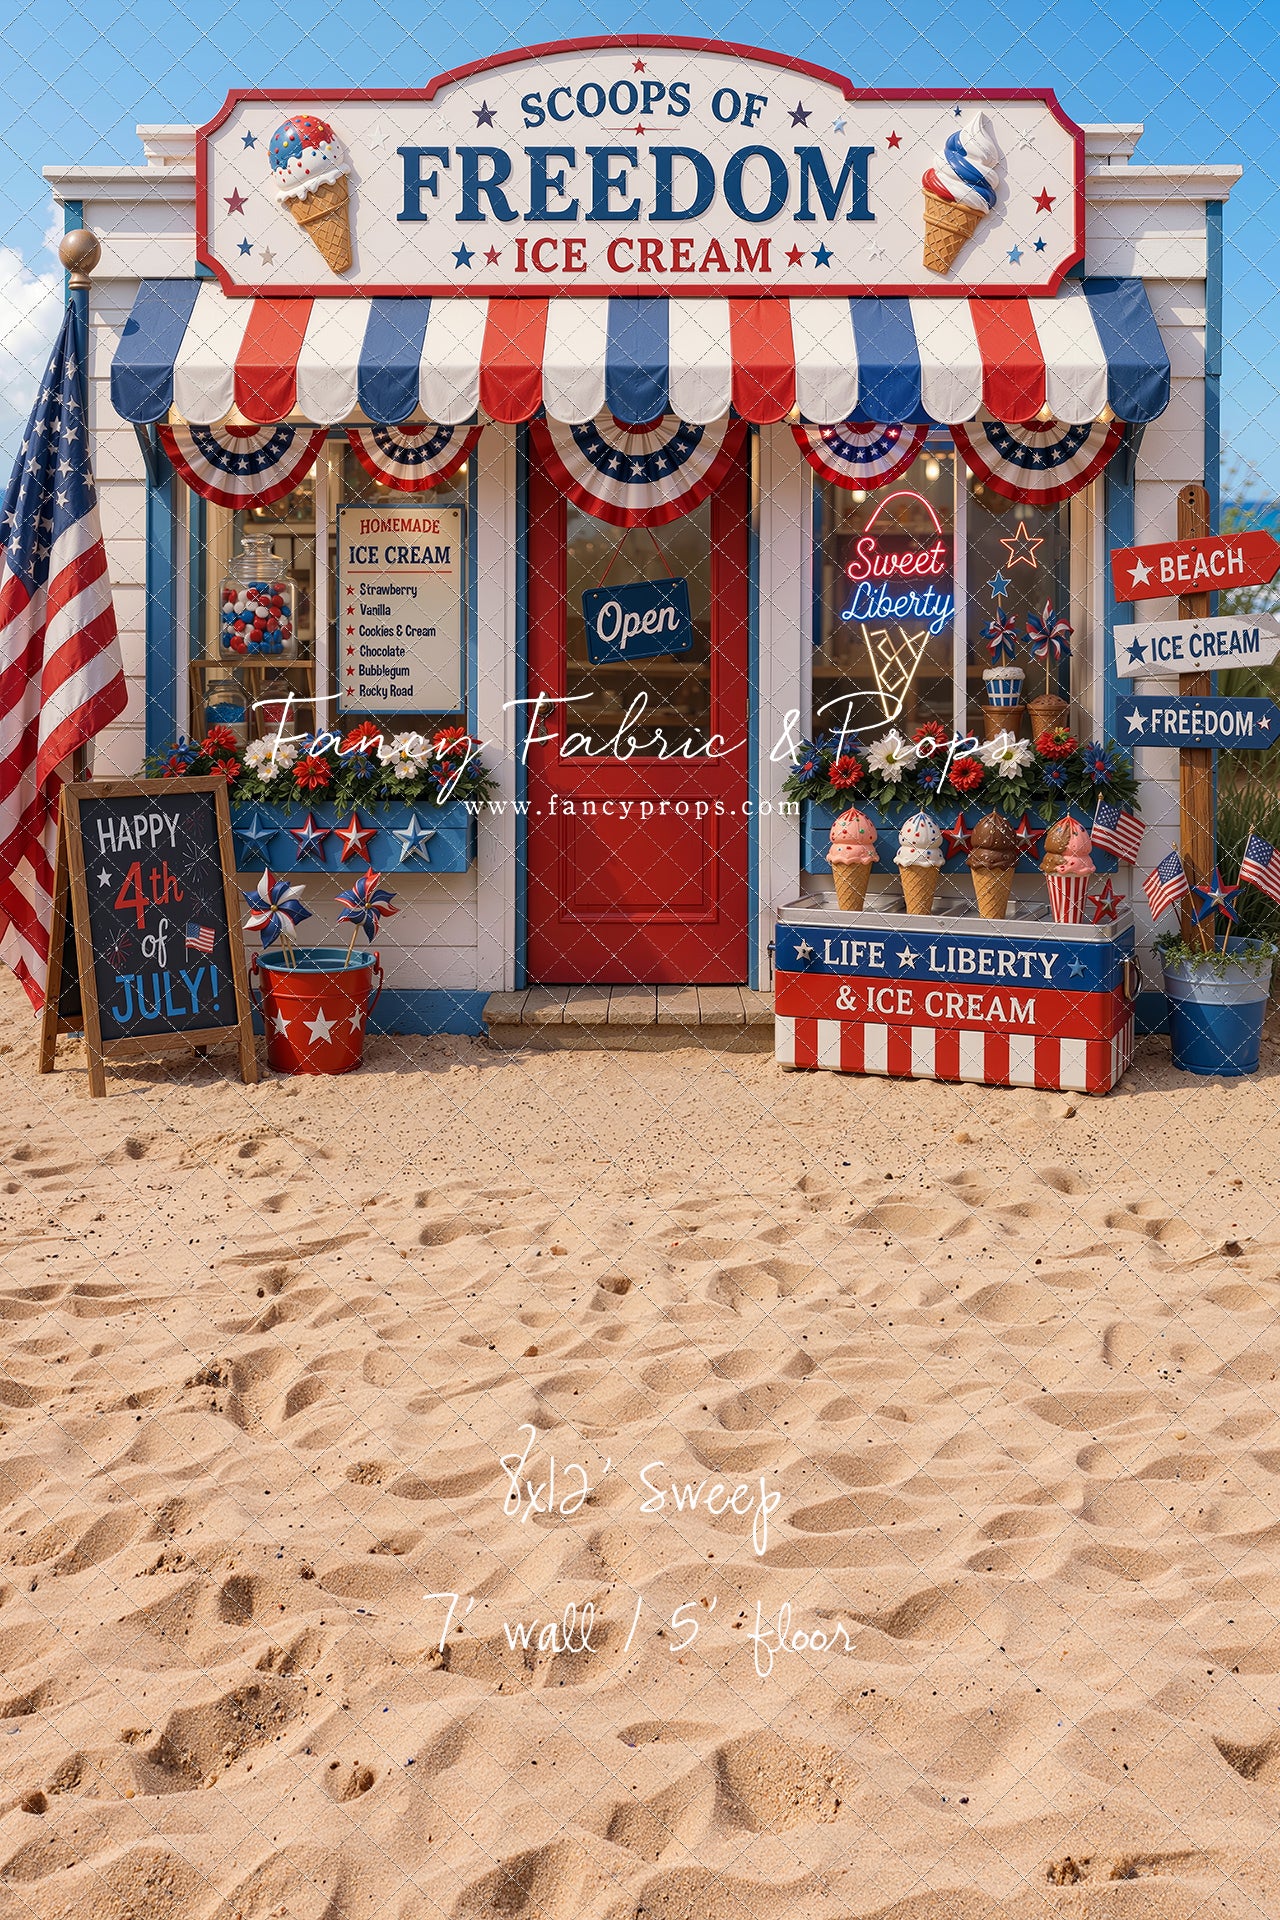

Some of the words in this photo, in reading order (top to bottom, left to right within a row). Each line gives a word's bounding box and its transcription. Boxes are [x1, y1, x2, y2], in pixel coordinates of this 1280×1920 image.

[521, 80, 691, 129] SCOOPS
[712, 87, 769, 127] OF
[395, 145, 876, 223] FREEDOM
[514, 238, 588, 273] ICE
[607, 237, 772, 273] CREAM
[360, 518, 440, 535] HOMEMADE
[349, 546, 379, 564] ICE
[385, 546, 451, 564] CREAM
[848, 537, 945, 580] Sweet
[1159, 548, 1244, 583] BEACH
[360, 583, 418, 598] Strawberry
[842, 582, 955, 634] Liberty
[360, 604, 391, 616] Vanilla
[597, 600, 680, 649] Open
[359, 625, 394, 637] Cookies
[397, 625, 403, 636] &
[406, 625, 436, 637] Cream
[1152, 635, 1184, 662] ICE
[1189, 628, 1260, 659] CREAM
[359, 645, 405, 657] Chocolate
[359, 665, 410, 679] Bubblegum
[359, 685, 388, 699] Rocky
[390, 685, 413, 697] Road
[1151, 708, 1253, 737] FREEDOM
[97, 813, 180, 853] HAPPY
[114, 860, 184, 930] 4th
[141, 918, 168, 968] of
[823, 939, 886, 969] LIFE
[928, 945, 1060, 980] LIBERTY
[112, 965, 220, 1024] JULY!
[835, 985, 857, 1012] &
[867, 987, 913, 1015] ICE
[925, 991, 1036, 1025] CREAM
